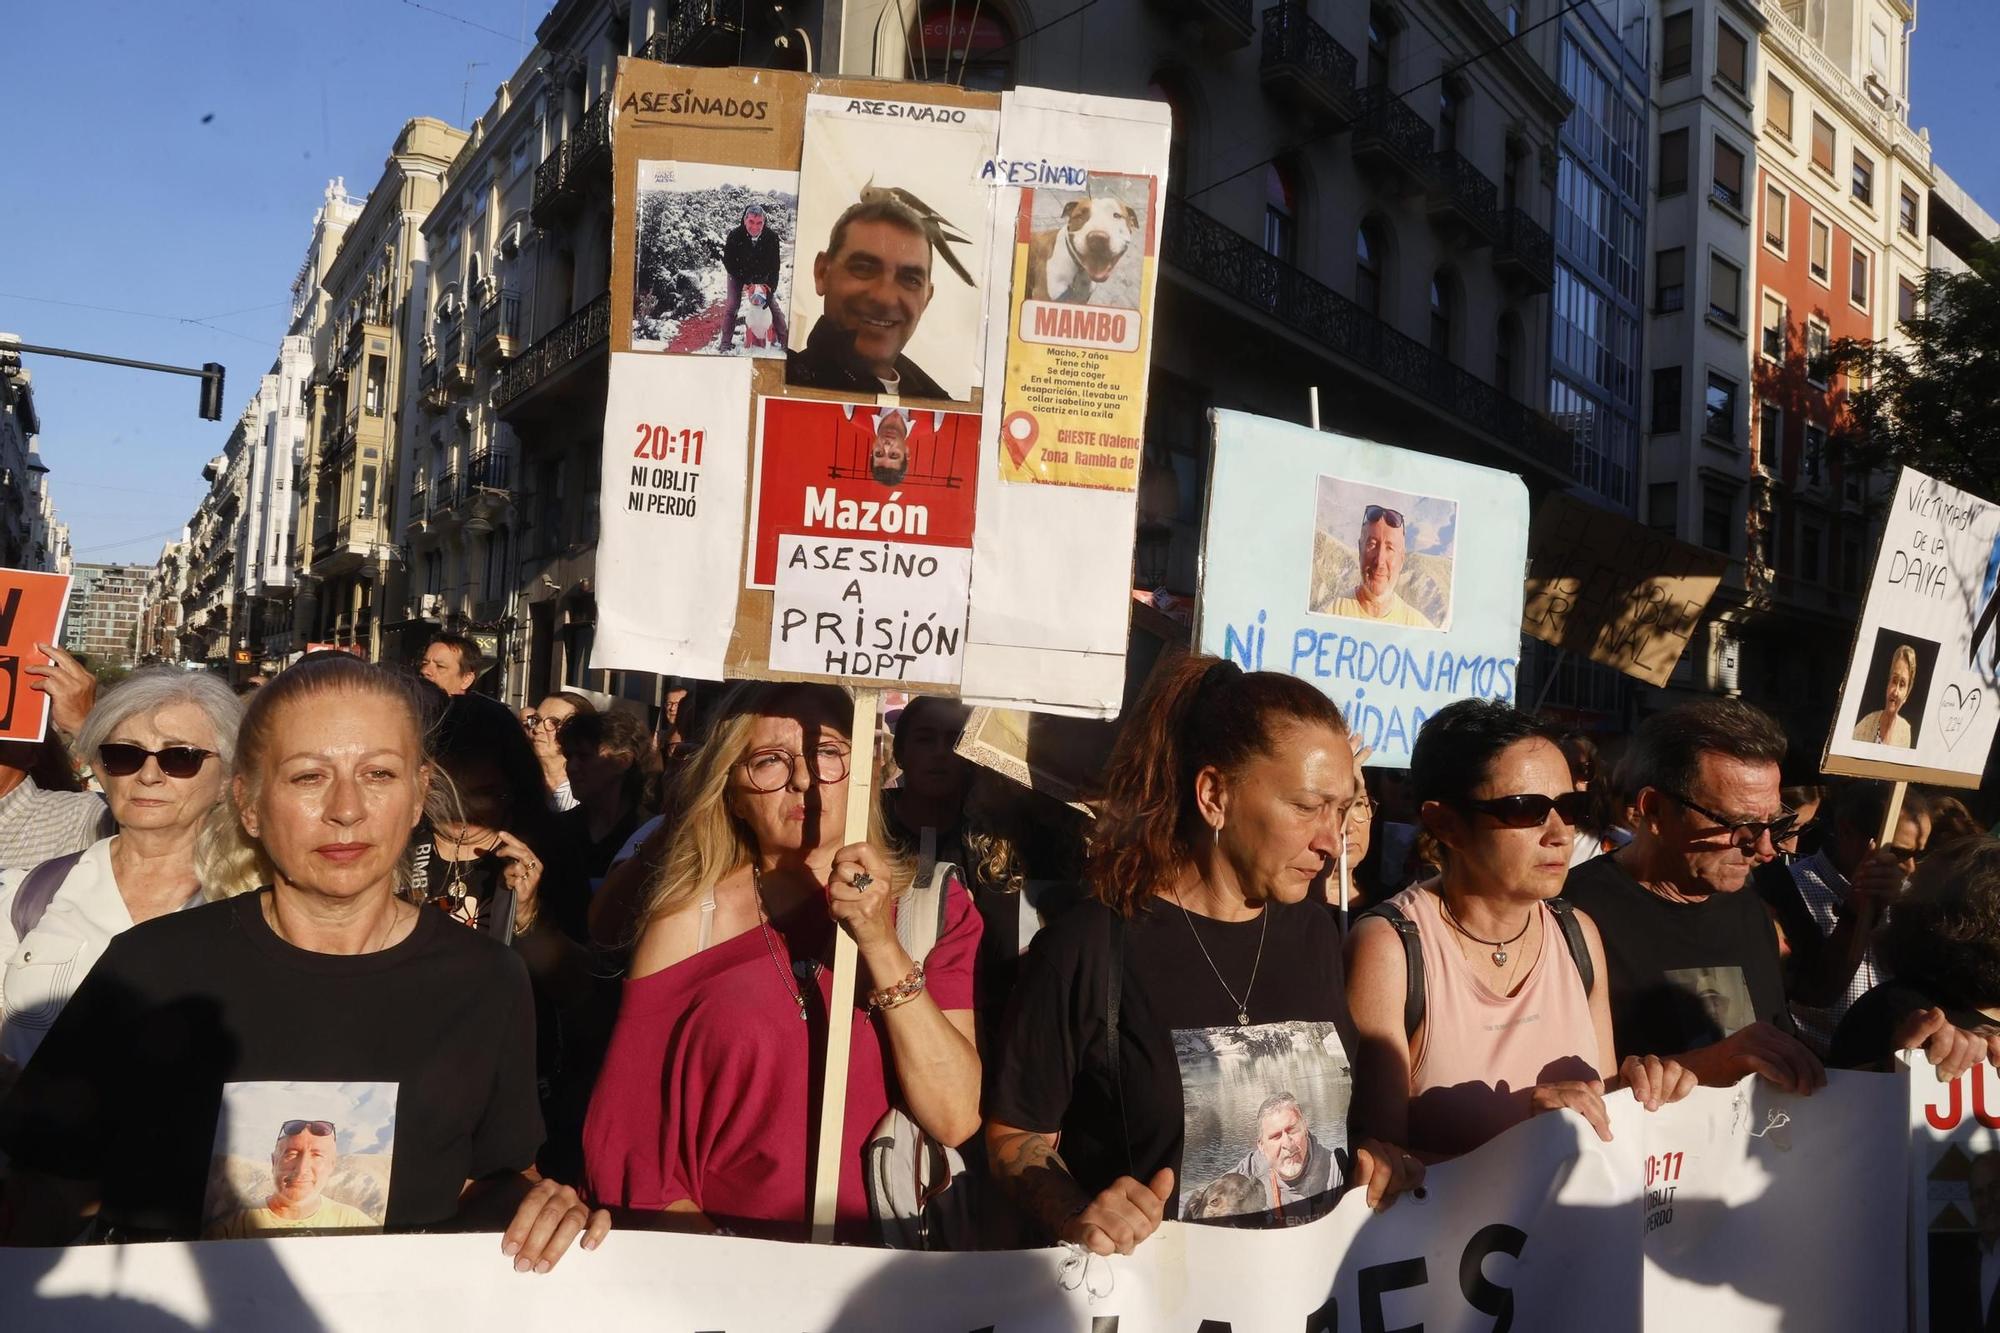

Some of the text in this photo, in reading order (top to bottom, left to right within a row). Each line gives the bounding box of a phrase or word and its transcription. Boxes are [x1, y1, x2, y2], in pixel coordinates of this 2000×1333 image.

[1035, 306, 1126, 343] MAMBO
[1055, 358, 1100, 371] Tiene chip
[1081, 350, 1086, 358] 7
[1088, 351, 1109, 360] años
[1031, 375, 1042, 384] En
[1043, 376, 1052, 384] el
[1054, 378, 1095, 389] momento
[1097, 381, 1108, 390] de
[1047, 367, 1105, 381] Se deja coger
[1027, 394, 1121, 410] collar isabelino y una
[1082, 388, 1116, 400] llevaba
[1118, 393, 1128, 401] un
[1033, 404, 1114, 419] cicatriz en la axila
[634, 423, 703, 466] 20:11
[1058, 428, 1096, 447] CHESTE
[1040, 448, 1134, 469] Zona Rambla de
[631, 465, 699, 493] NI OBLIT
[628, 491, 696, 518] NI PERDÓ
[803, 486, 928, 536] Mazón
[1913, 530, 1928, 551] DE
[1888, 551, 1947, 600] DANA
[842, 579, 861, 604] A
[826, 650, 918, 680] HDPT
[1291, 628, 1517, 704] PERDONAMOS
